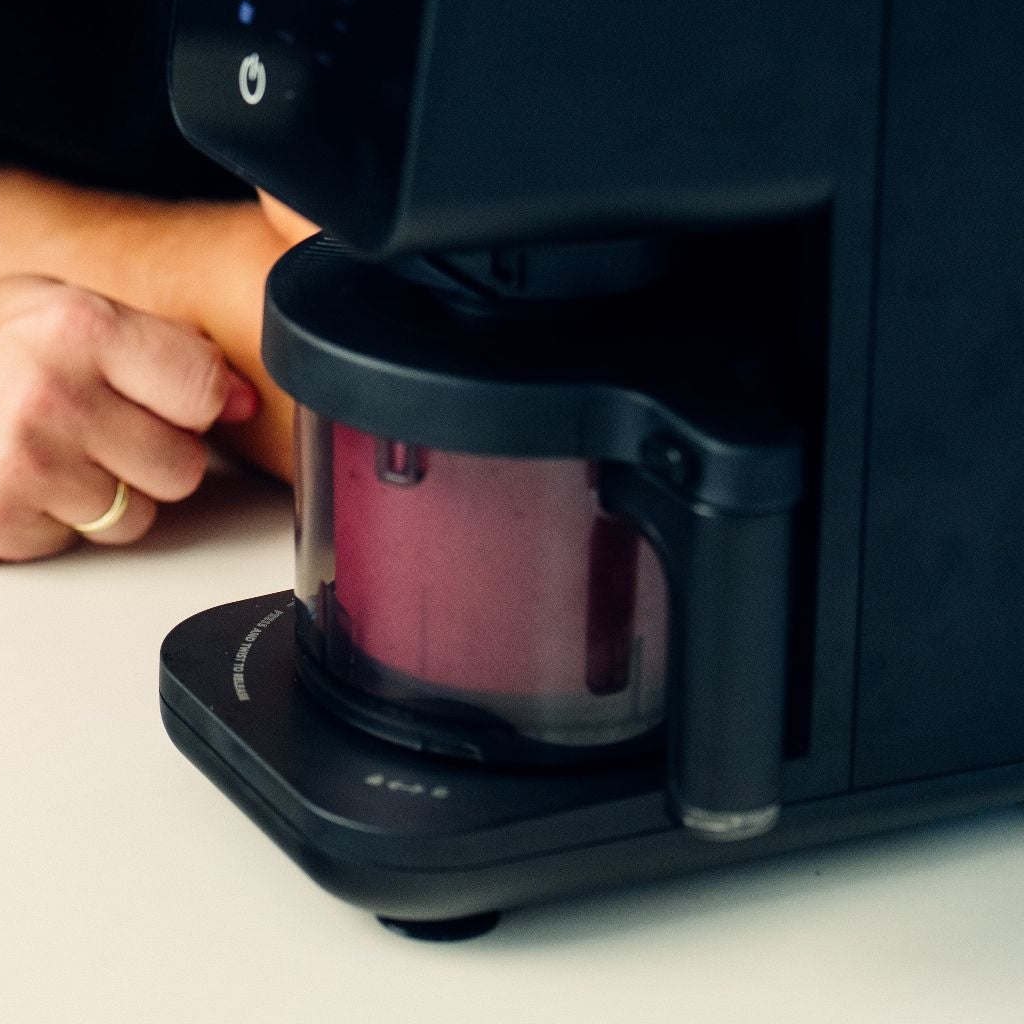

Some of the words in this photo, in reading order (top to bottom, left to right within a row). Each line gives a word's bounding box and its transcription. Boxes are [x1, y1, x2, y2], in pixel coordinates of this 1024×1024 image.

[245, 627, 263, 642] AND
[235, 643, 252, 663] TWIST
[233, 663, 245, 673] TO
